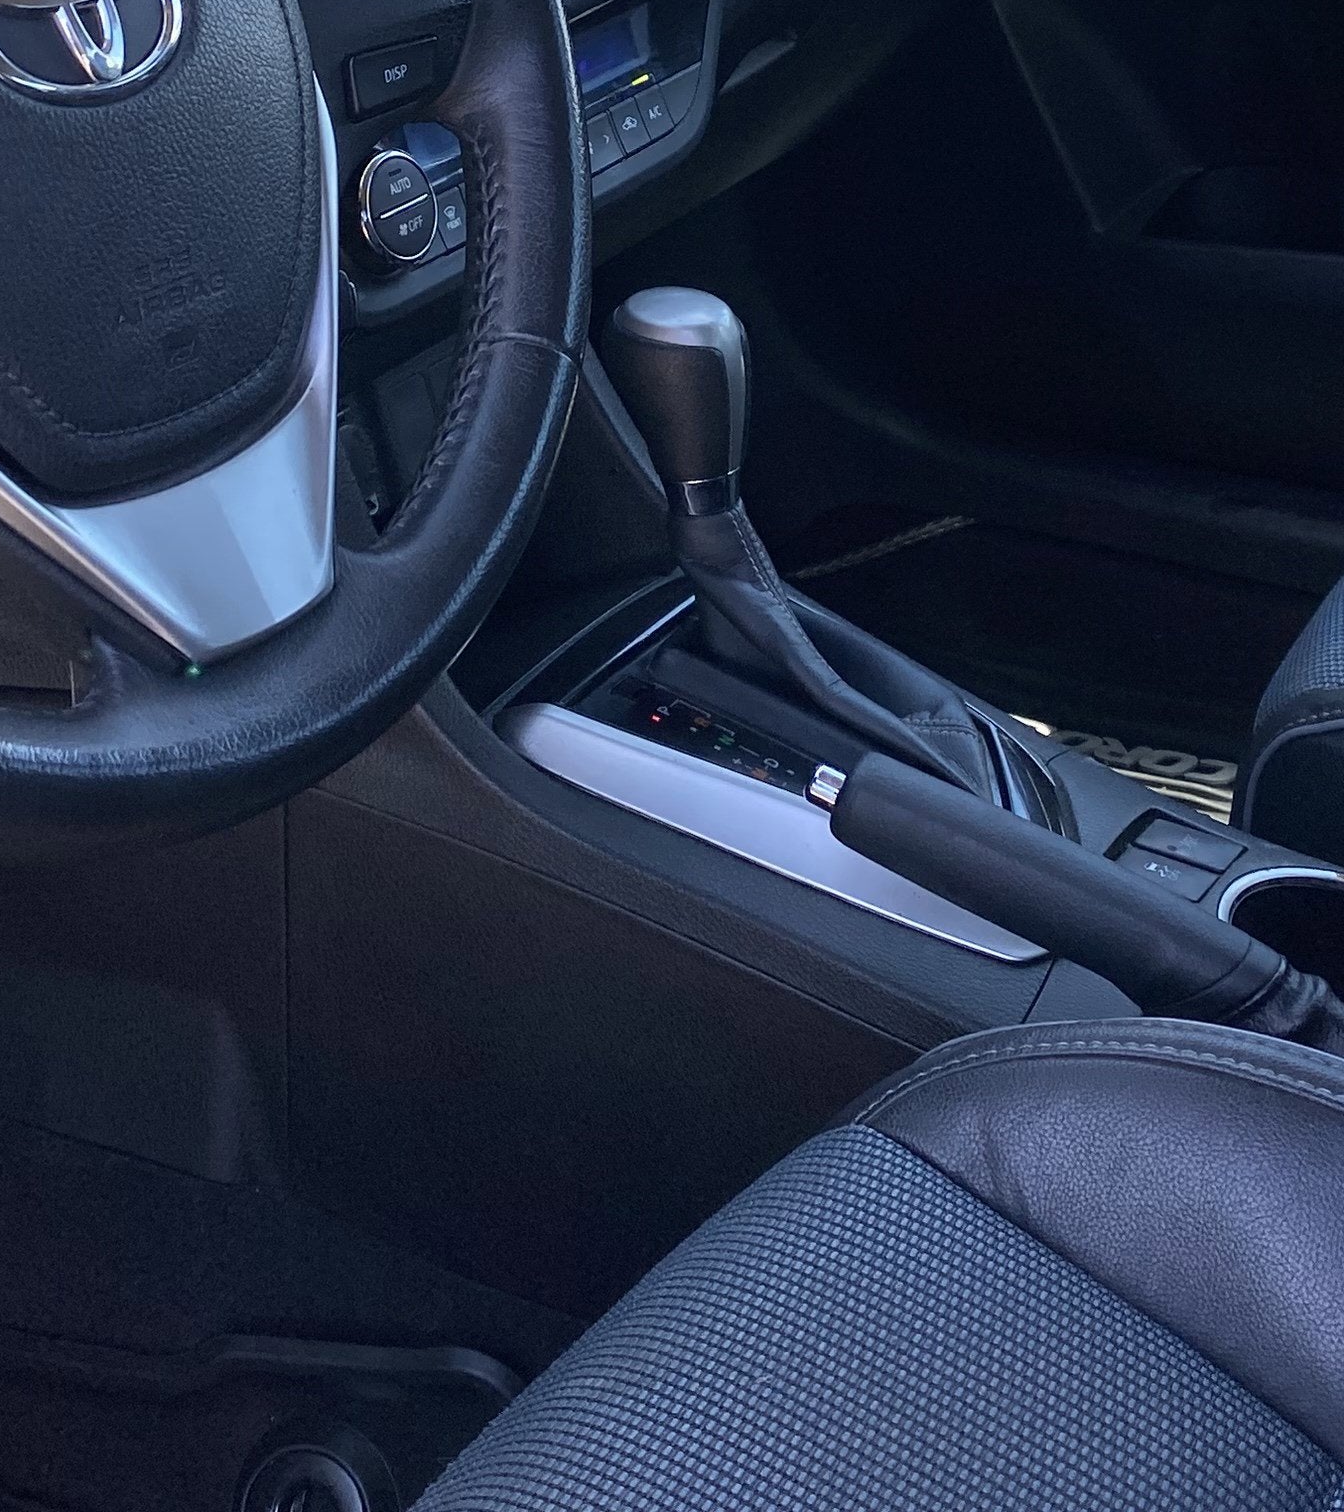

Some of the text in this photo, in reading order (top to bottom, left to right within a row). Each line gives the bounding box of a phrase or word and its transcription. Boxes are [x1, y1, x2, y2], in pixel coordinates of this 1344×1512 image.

[384, 64, 408, 83] DISP
[648, 105, 663, 120] A/C
[389, 176, 412, 195] AUTO
[408, 214, 424, 231] OFF
[657, 706, 670, 716] P
